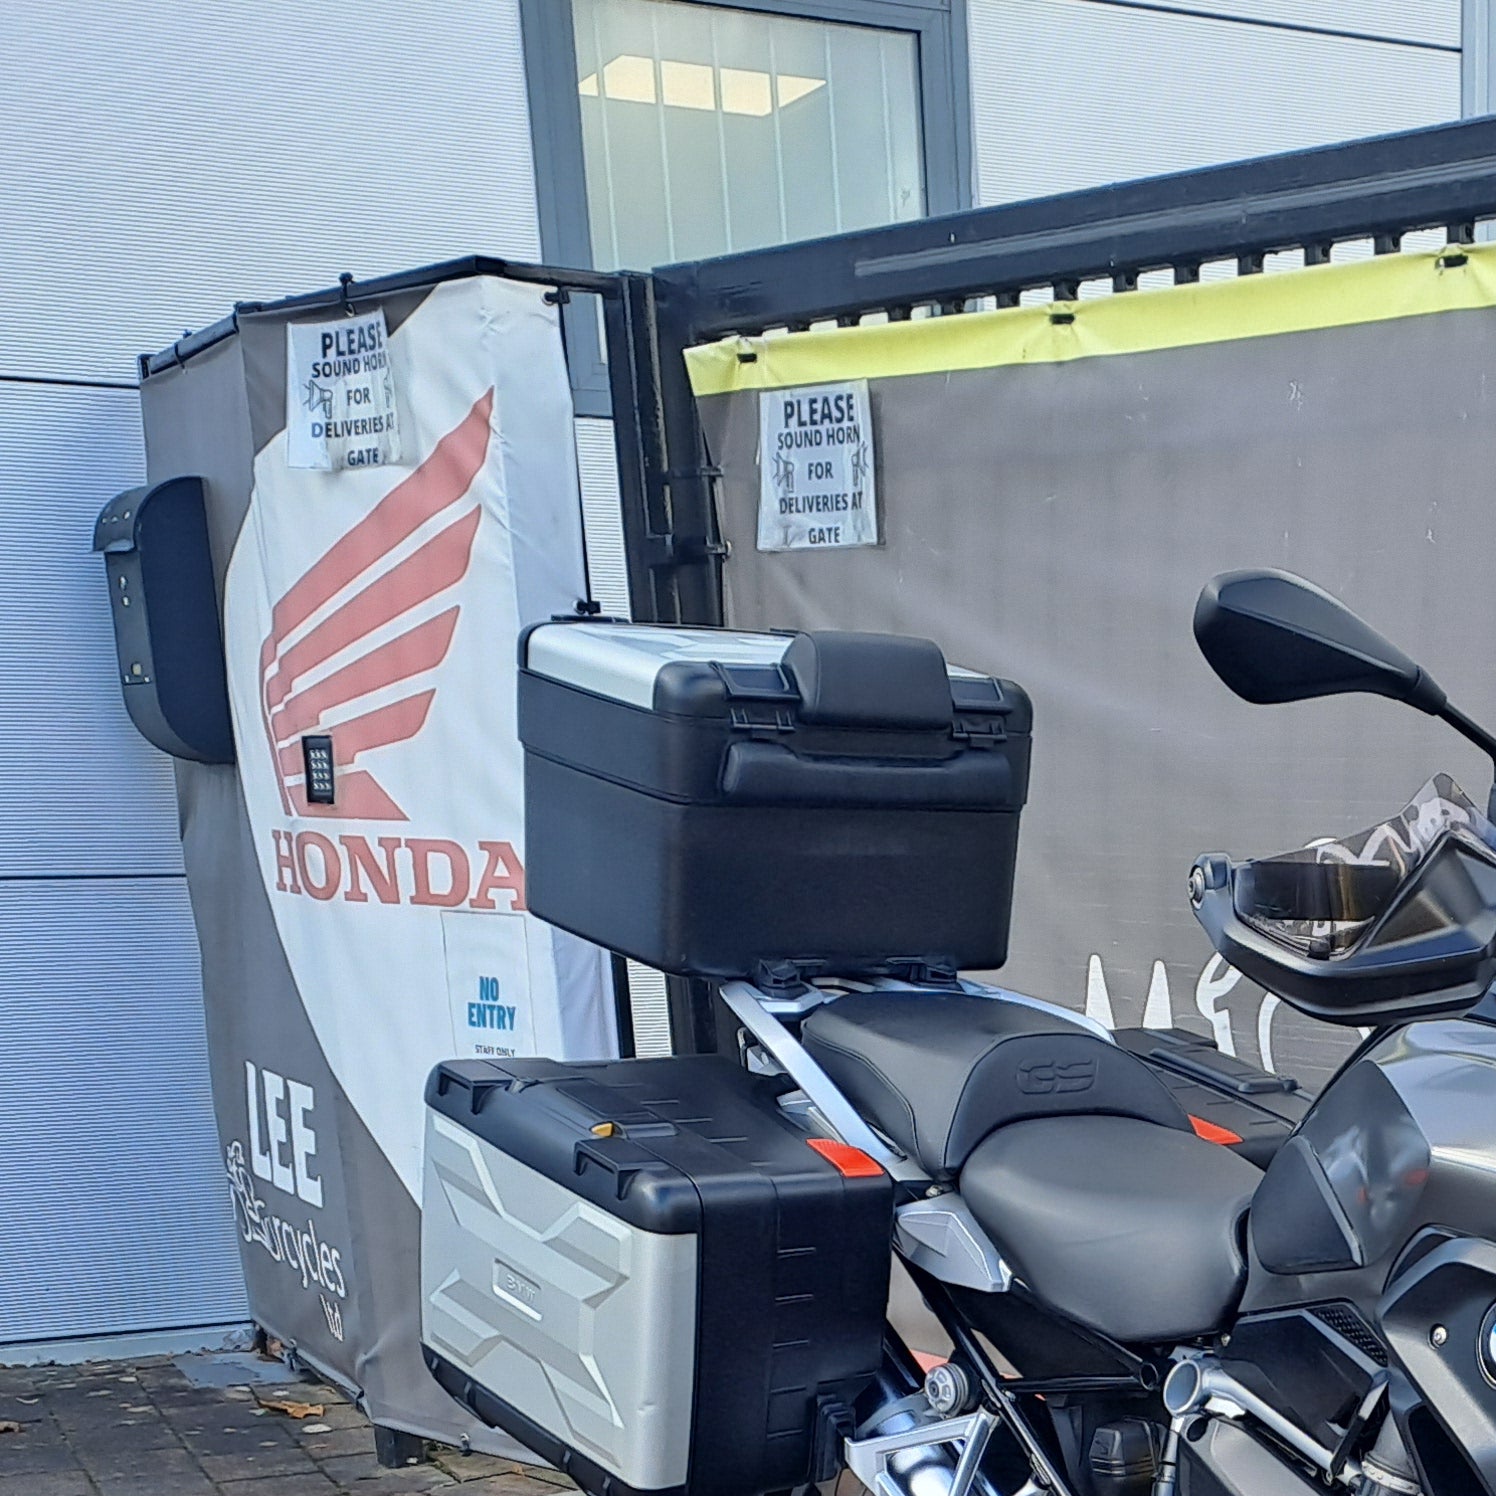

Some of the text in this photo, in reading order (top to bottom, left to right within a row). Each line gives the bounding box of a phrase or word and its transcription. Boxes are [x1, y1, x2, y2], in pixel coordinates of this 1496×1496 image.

[321, 322, 382, 358] PLEASE
[312, 358, 360, 378] SOUND
[347, 387, 371, 406] FOR
[783, 393, 855, 428] PLEASE
[311, 417, 384, 438] DELIVERIES
[777, 423, 860, 450] SOUND HORN
[347, 447, 379, 466] GATE
[807, 461, 834, 480] FOR
[779, 491, 863, 514] DELIVERIES AT
[808, 527, 840, 544] GATE
[271, 828, 528, 911] HONDA
[479, 976, 499, 1002] NO
[467, 1002, 516, 1031] ENTRY
[245, 1060, 323, 1208] LEE
